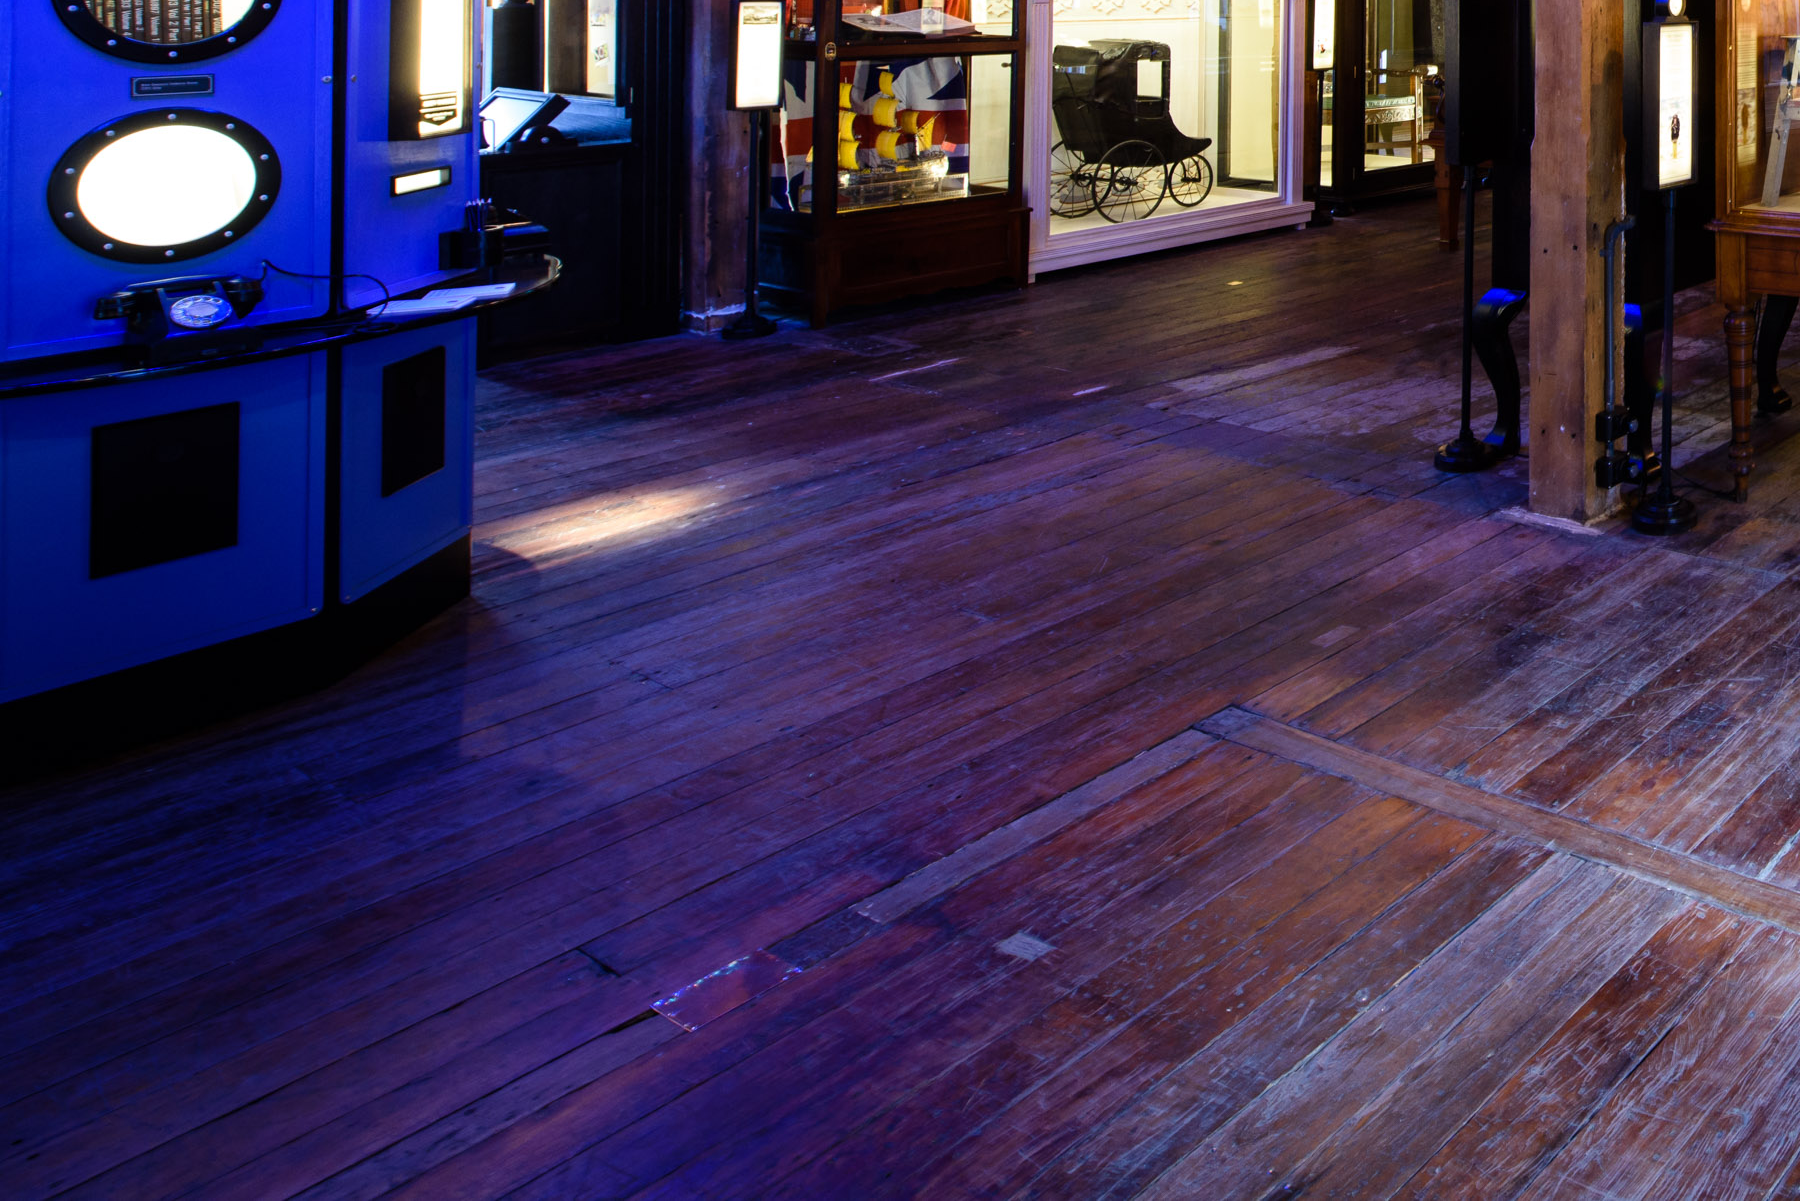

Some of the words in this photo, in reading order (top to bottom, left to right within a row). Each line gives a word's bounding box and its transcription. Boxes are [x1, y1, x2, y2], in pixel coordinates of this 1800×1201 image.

[122, 10, 132, 30] Volume
[168, 8, 179, 19] Vol
[151, 16, 160, 35] Volume
[169, 28, 179, 41] Part
